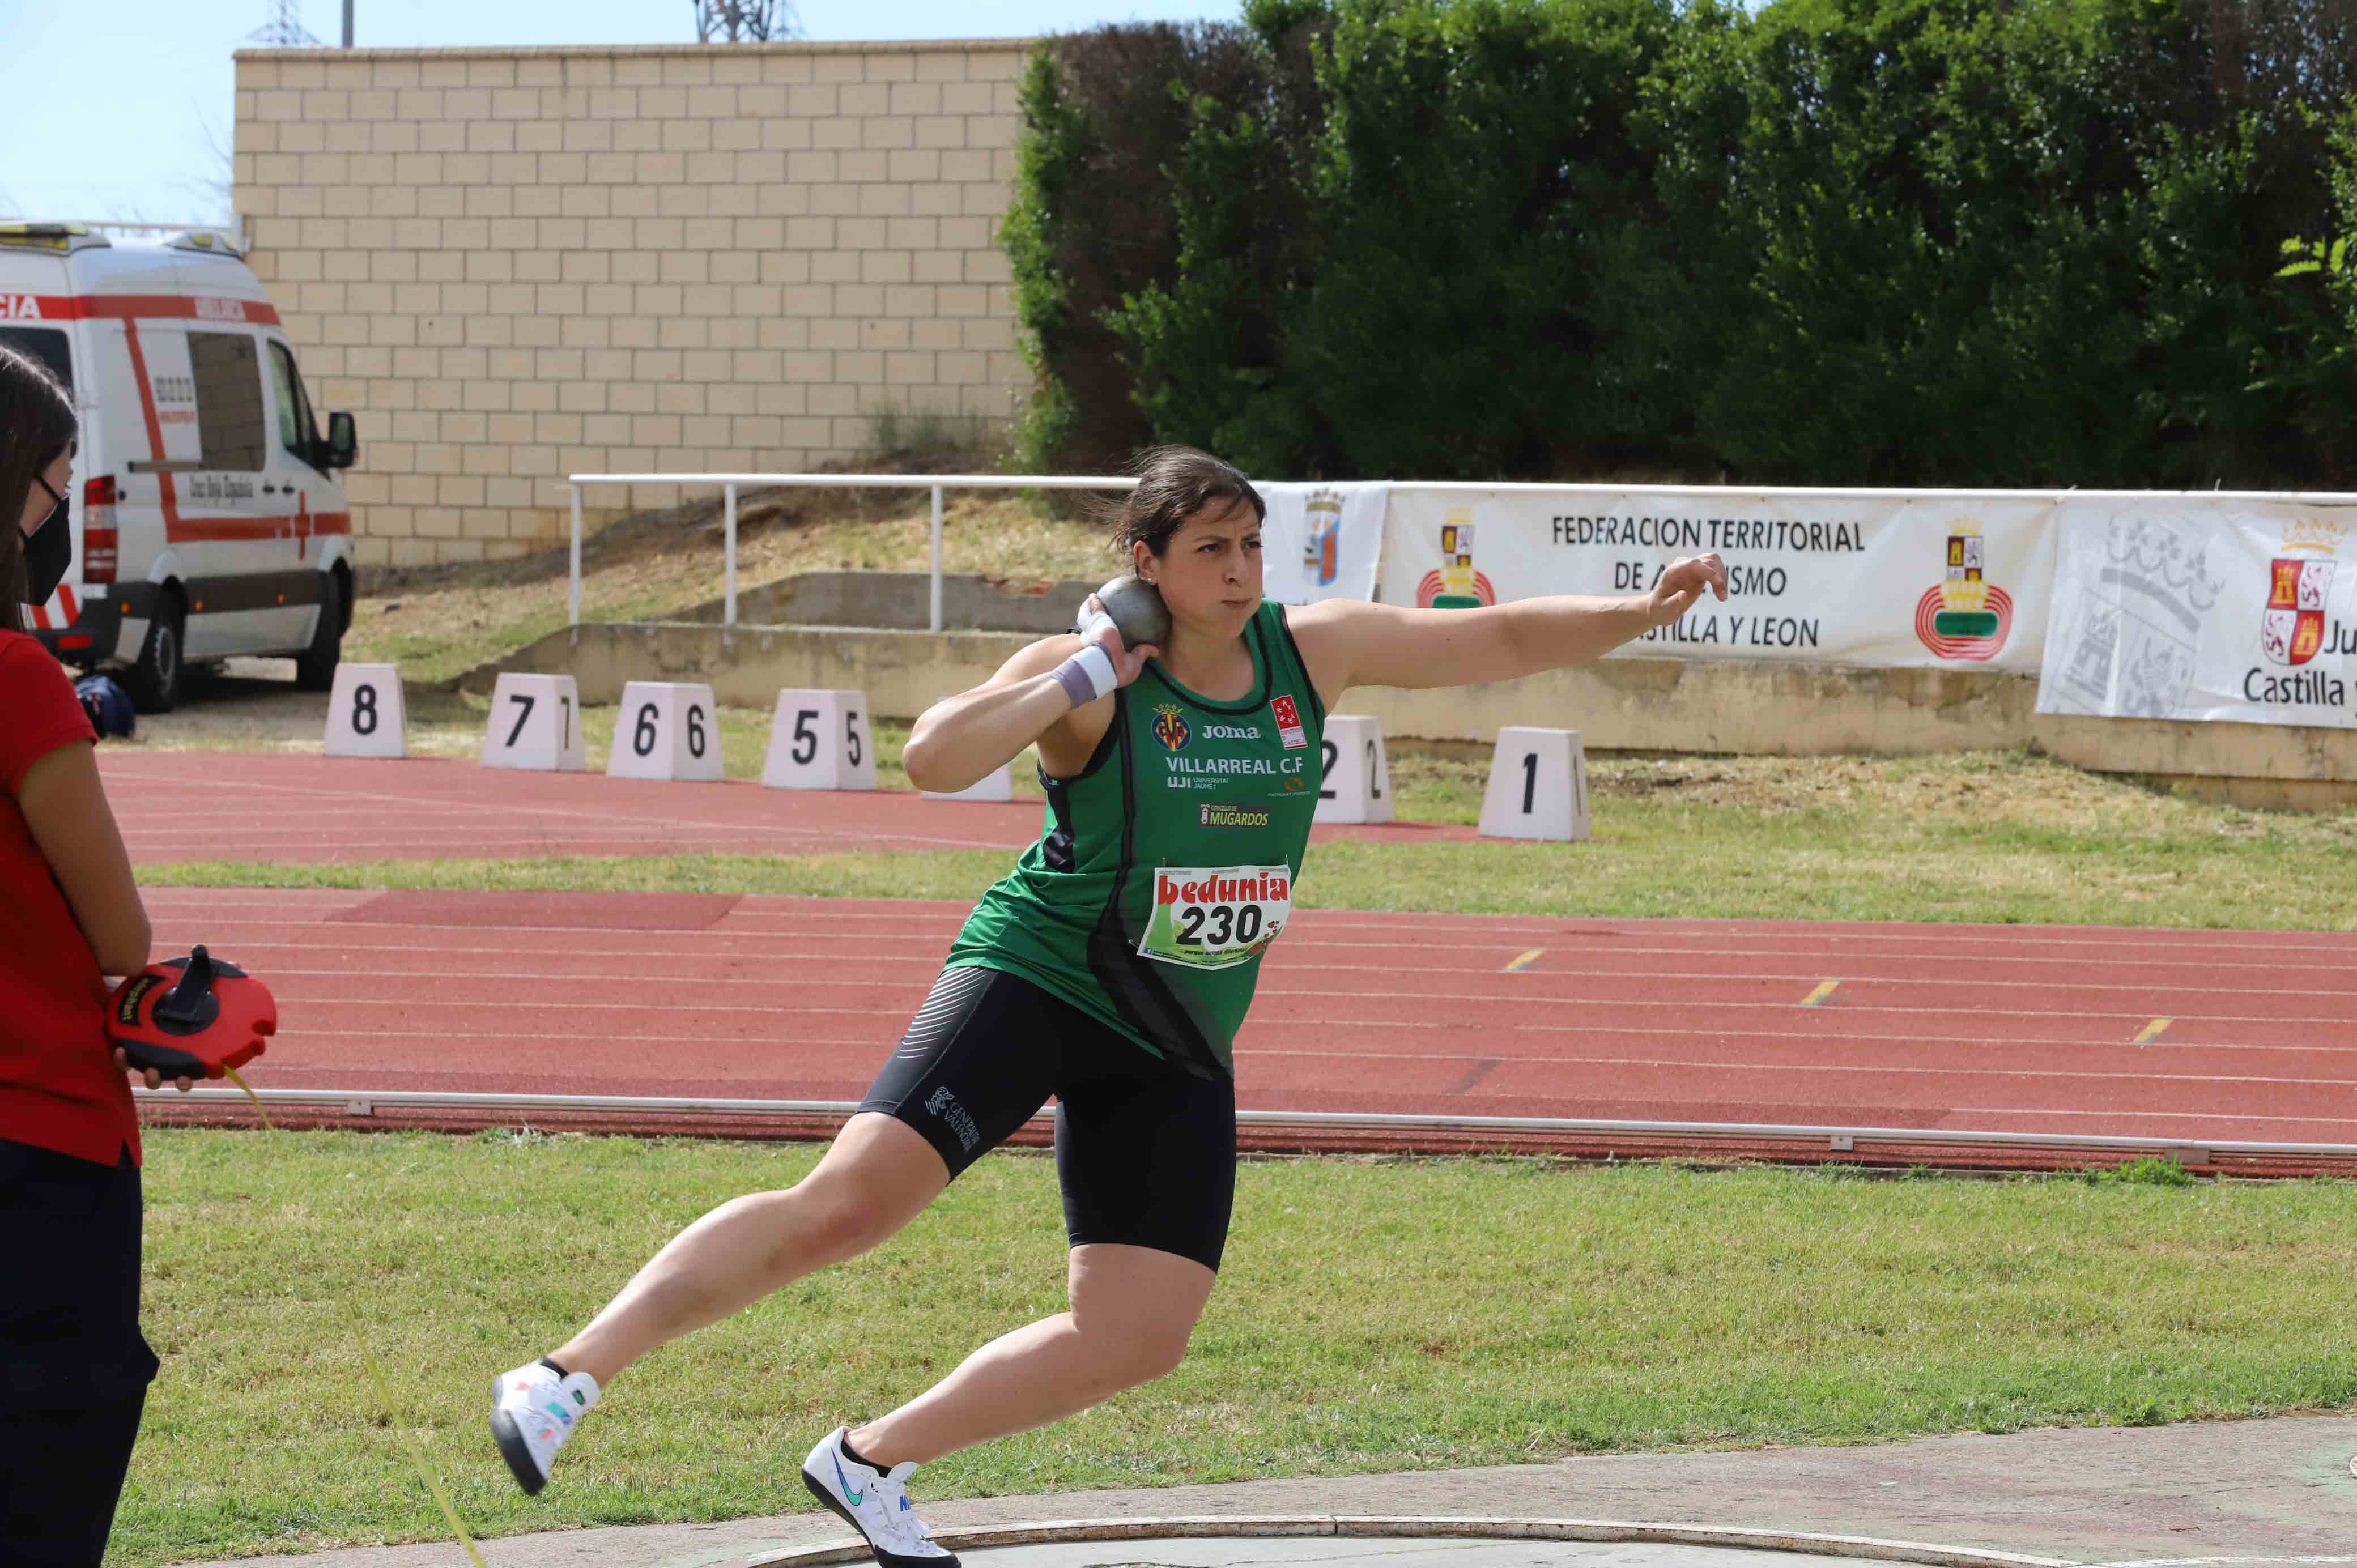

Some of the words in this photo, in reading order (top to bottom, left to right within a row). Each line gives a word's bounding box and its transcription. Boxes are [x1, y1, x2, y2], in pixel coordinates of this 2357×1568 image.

[1552, 517, 1700, 548] FEDERACION
[1707, 519, 1865, 552] TERRITORIAL
[1615, 562, 1643, 590] DE
[1730, 616, 1744, 645] Y
[1751, 617, 1819, 647] LEON
[352, 684, 377, 735] 8
[2244, 667, 2344, 706] Castilla
[505, 694, 535, 747] 7
[633, 703, 659, 756] 6
[687, 704, 705, 759] 6
[792, 710, 819, 765] 5
[846, 711, 861, 766] 5
[1165, 757, 1277, 774] VILLARREAL
[1320, 739, 1339, 799] 2
[1367, 739, 1381, 798] 2
[1522, 753, 1538, 814] 1
[1210, 812, 1269, 825] MUGARDOS
[1158, 872, 1288, 905] bedunia
[1176, 905, 1262, 945] 230
